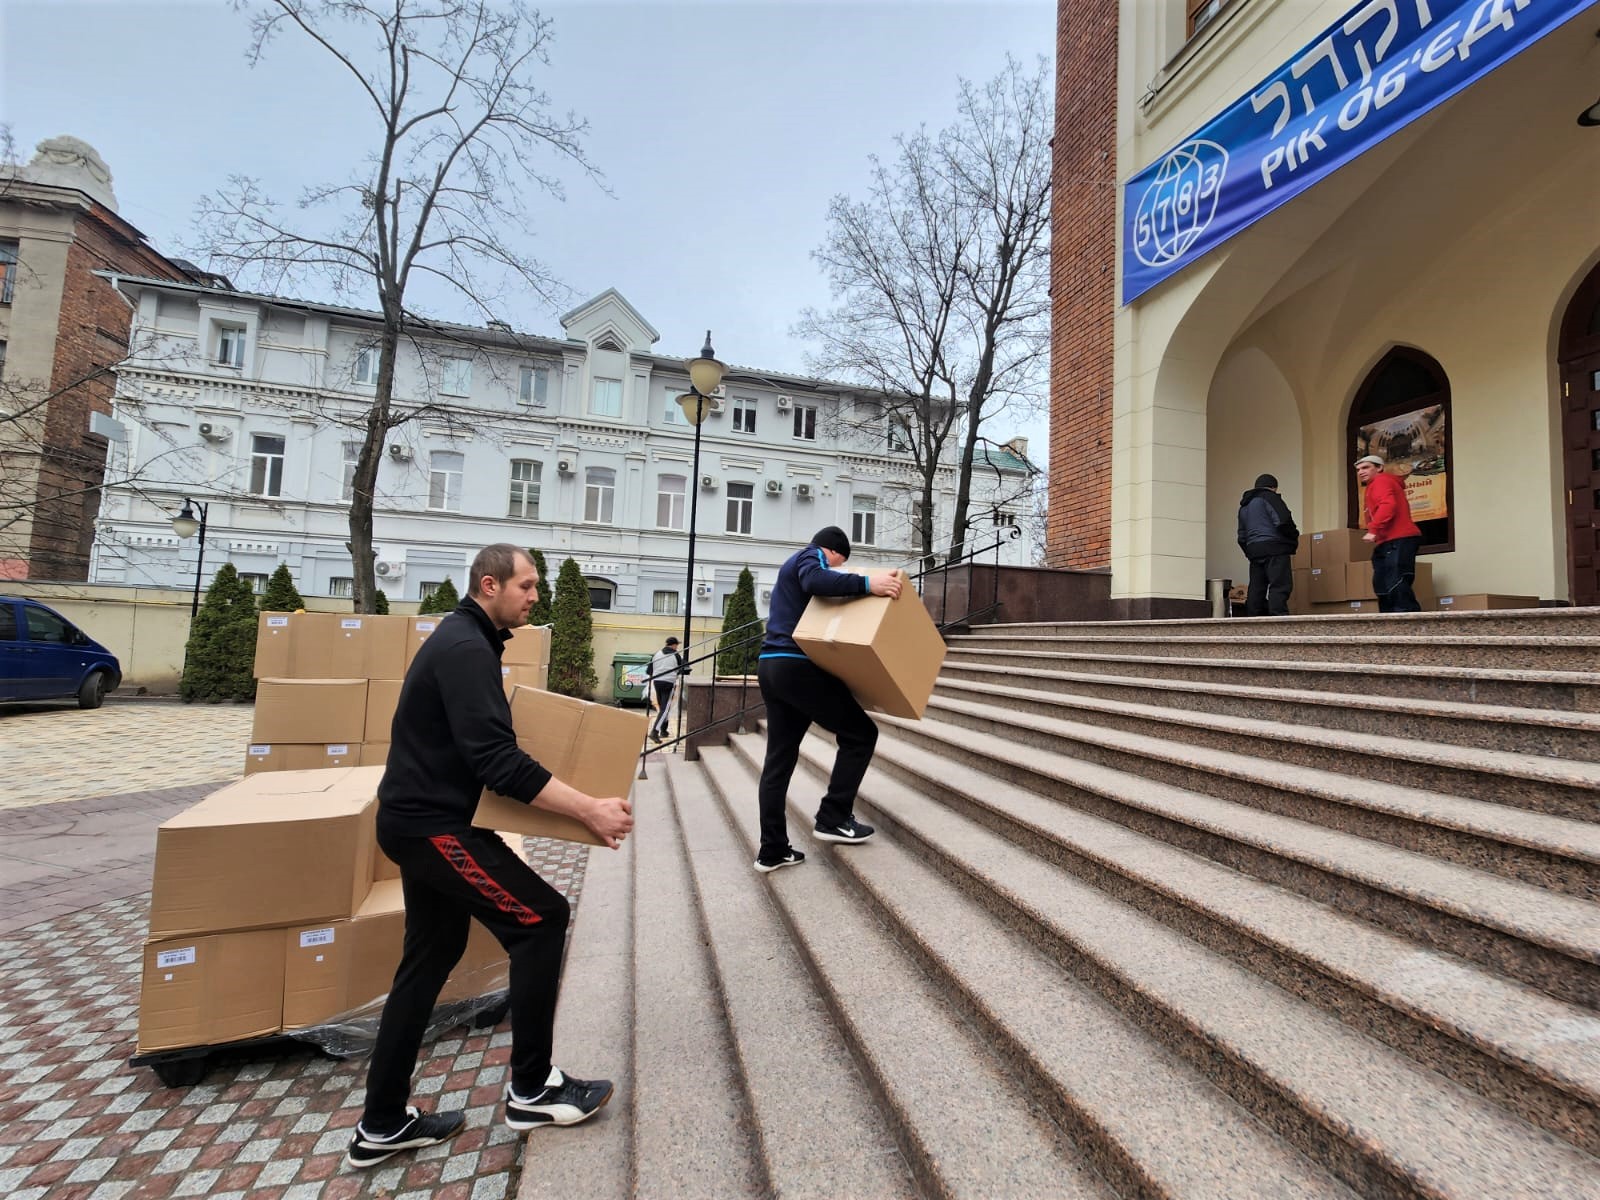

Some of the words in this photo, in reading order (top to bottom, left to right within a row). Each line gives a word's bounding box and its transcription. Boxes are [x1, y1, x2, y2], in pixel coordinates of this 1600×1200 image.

[1250, 0, 1432, 140] קהל
[1261, 115, 1328, 189] РІК
[1338, 0, 1531, 131] ОБ'ЄД
[1138, 163, 1219, 248] 5783
